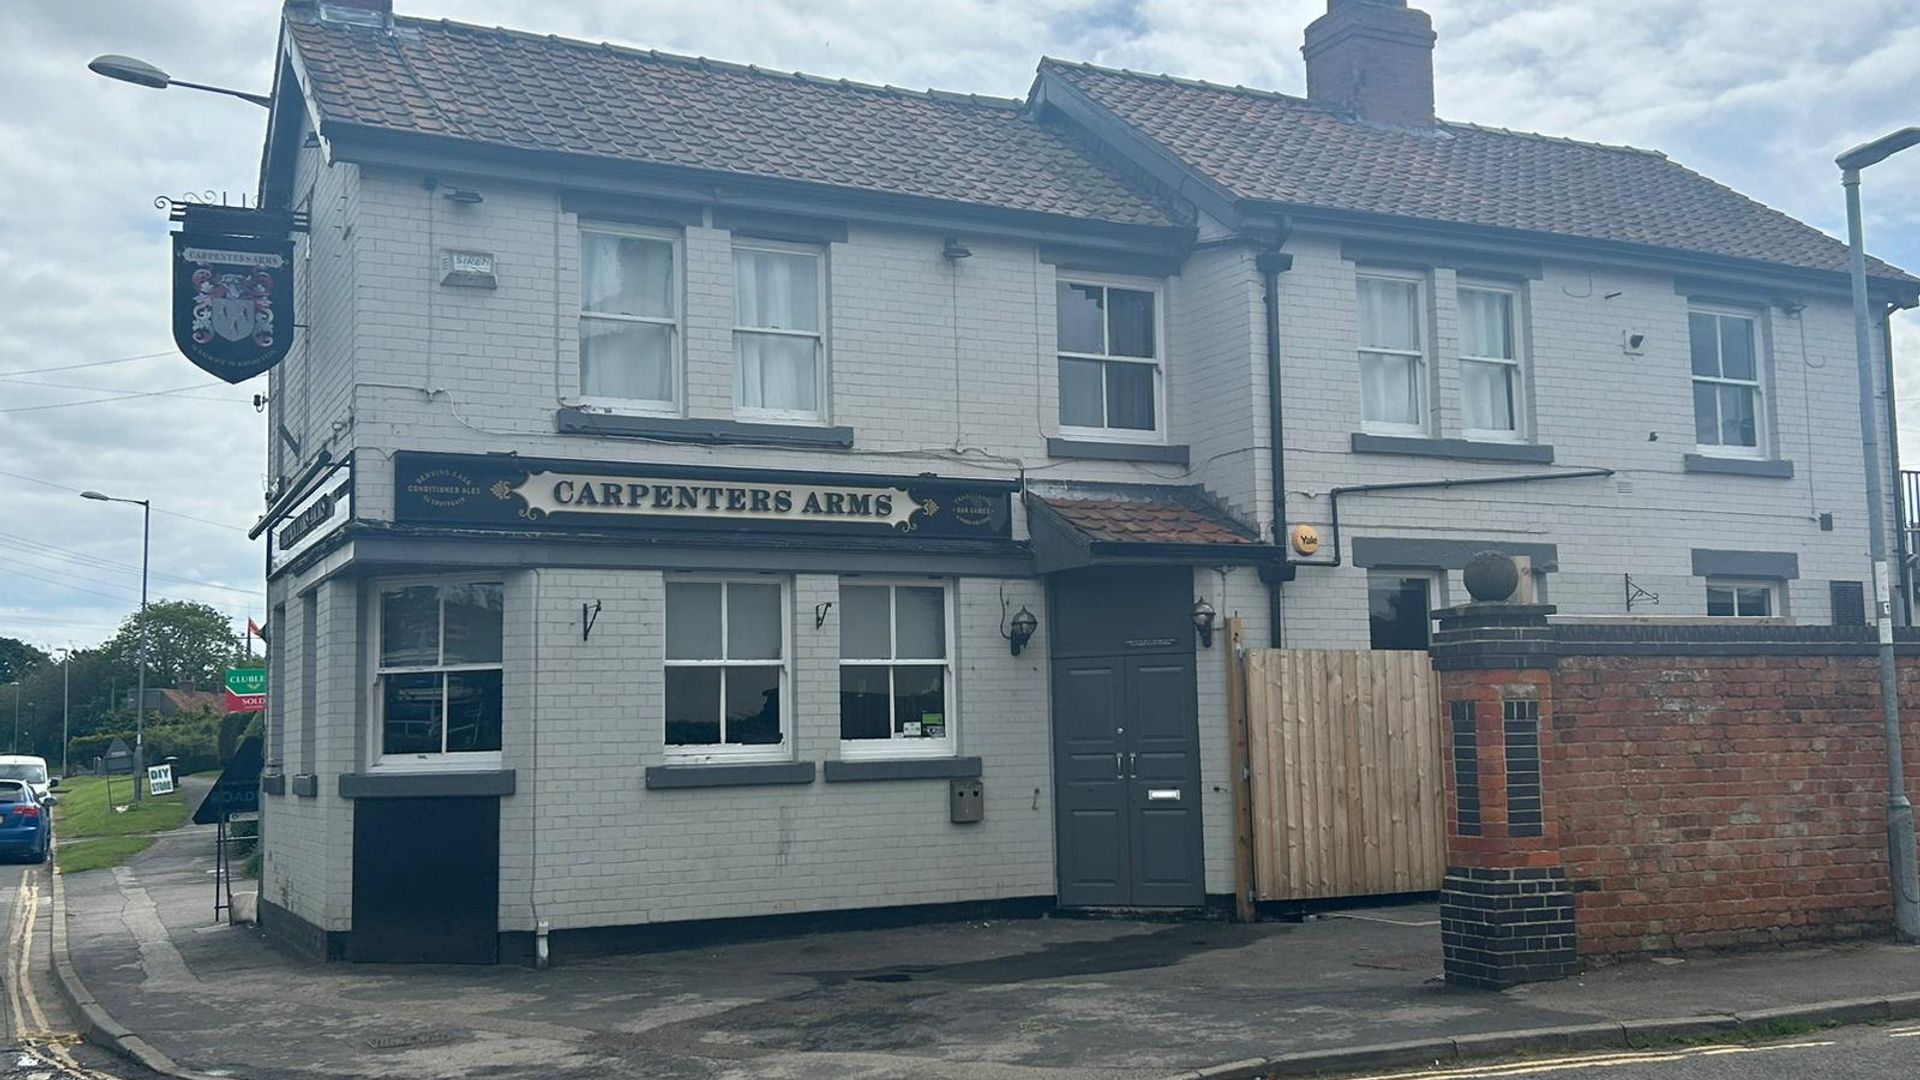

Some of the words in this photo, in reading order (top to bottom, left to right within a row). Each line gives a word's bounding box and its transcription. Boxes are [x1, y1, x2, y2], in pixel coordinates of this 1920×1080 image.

[189, 250, 251, 263] CARPENTERS
[253, 255, 278, 265] ARMS
[407, 484, 460, 494] CONDITIONED
[461, 486, 481, 495] ALES
[553, 481, 793, 515] CARPENTERS
[801, 490, 893, 518] ARMS
[1300, 535, 1318, 544] Yale
[242, 697, 266, 705] SOLD
[150, 768, 169, 780] DIY
